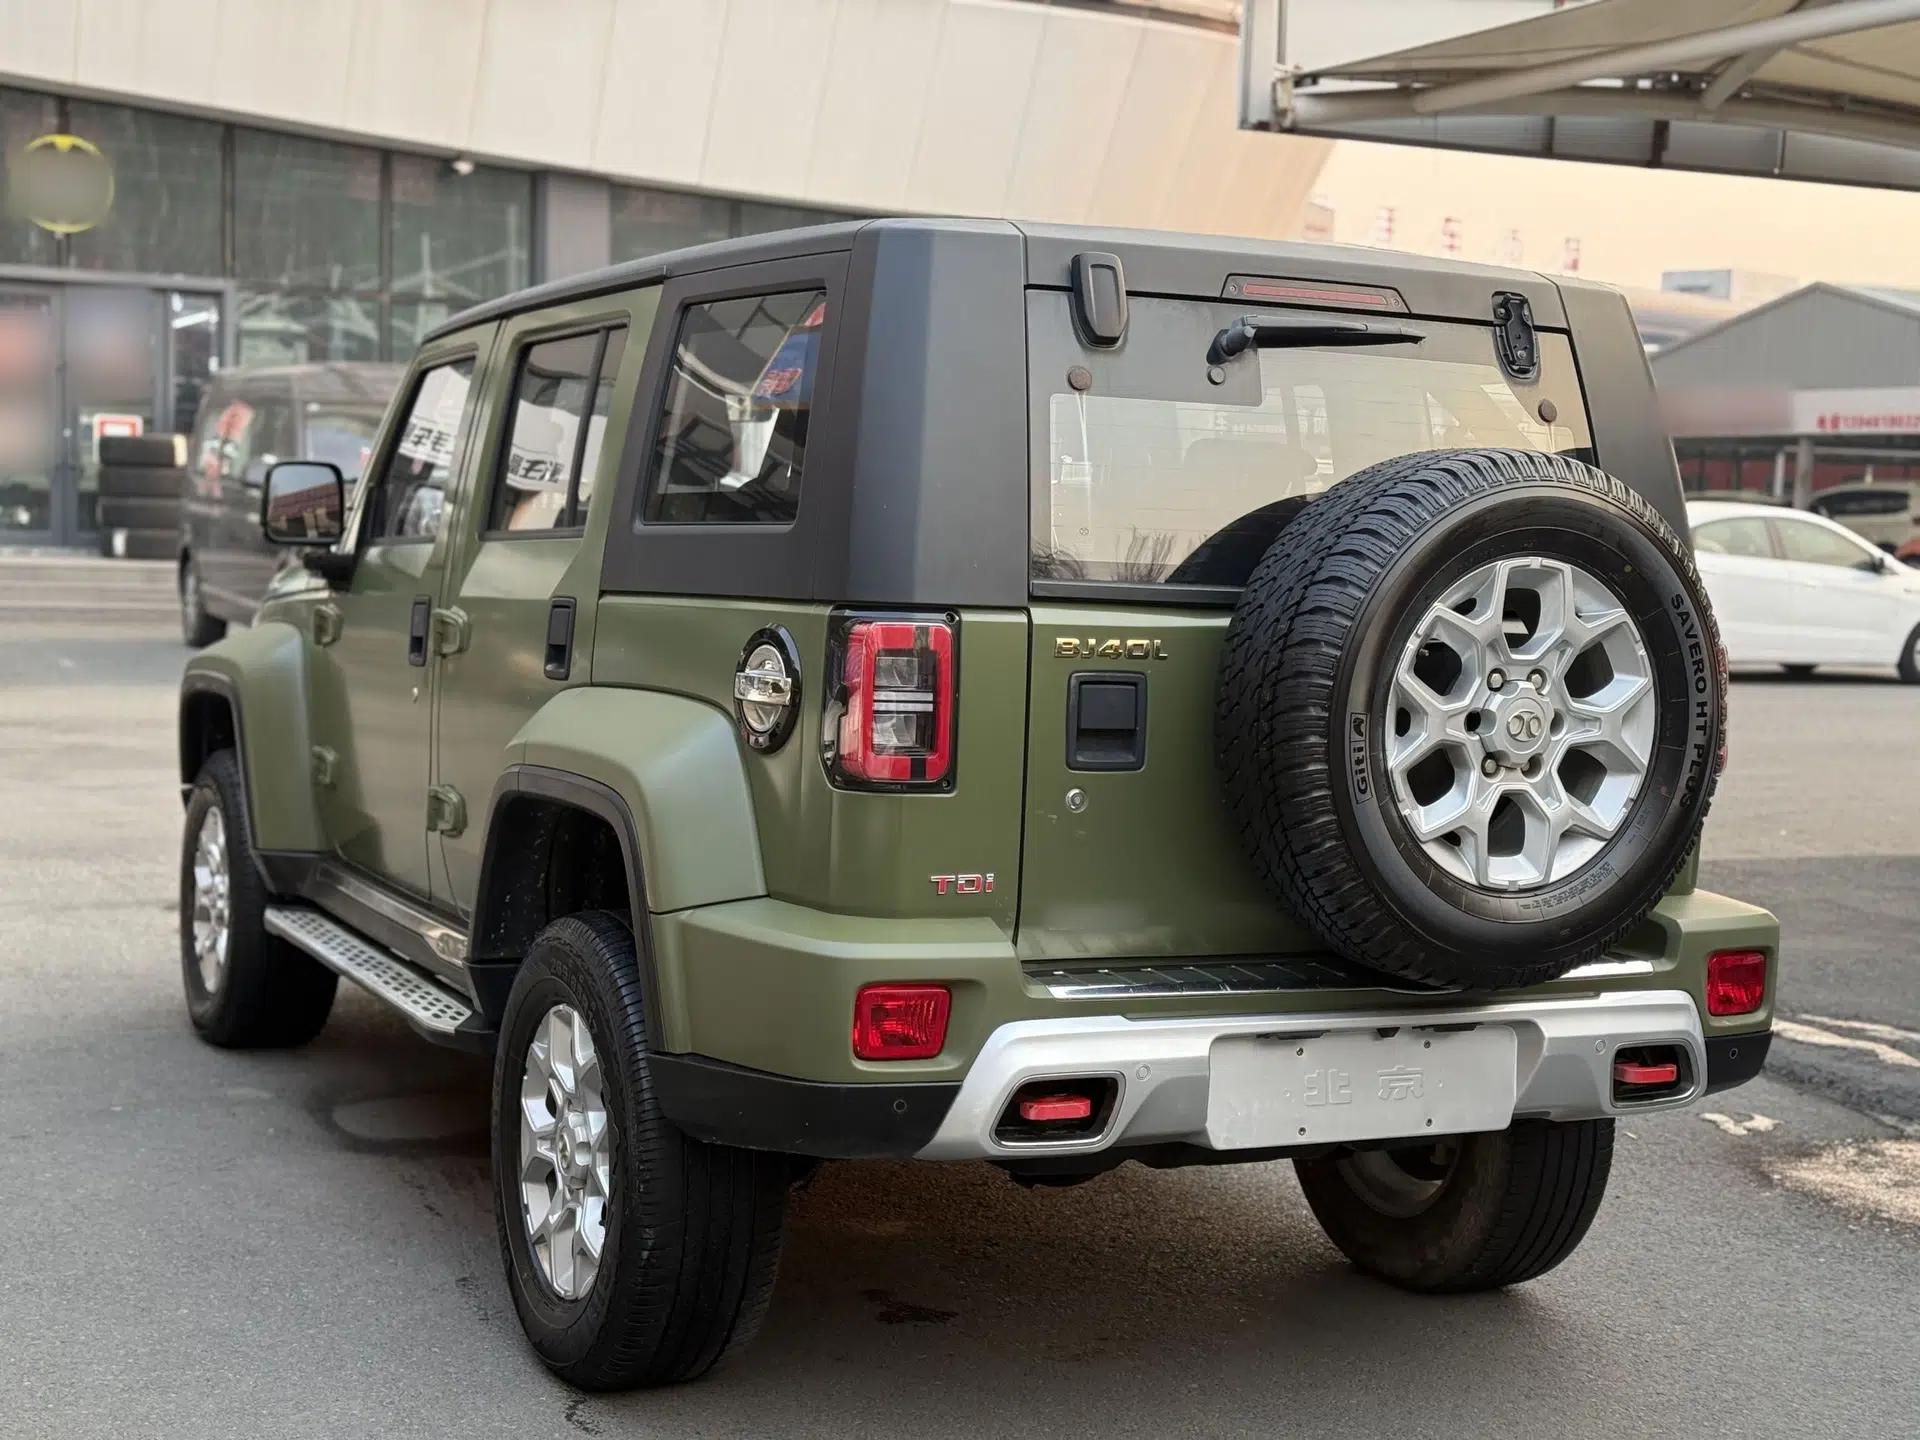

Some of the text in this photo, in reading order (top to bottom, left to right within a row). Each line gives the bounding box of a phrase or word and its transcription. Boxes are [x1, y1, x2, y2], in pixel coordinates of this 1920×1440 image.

[1054, 637, 1168, 660] BJ40L
[1671, 592, 1708, 808] SAVERO HT PLUS
[1353, 746, 1368, 795] Giti
[930, 873, 995, 895] TDi
[1303, 1064, 1425, 1107] 北京
